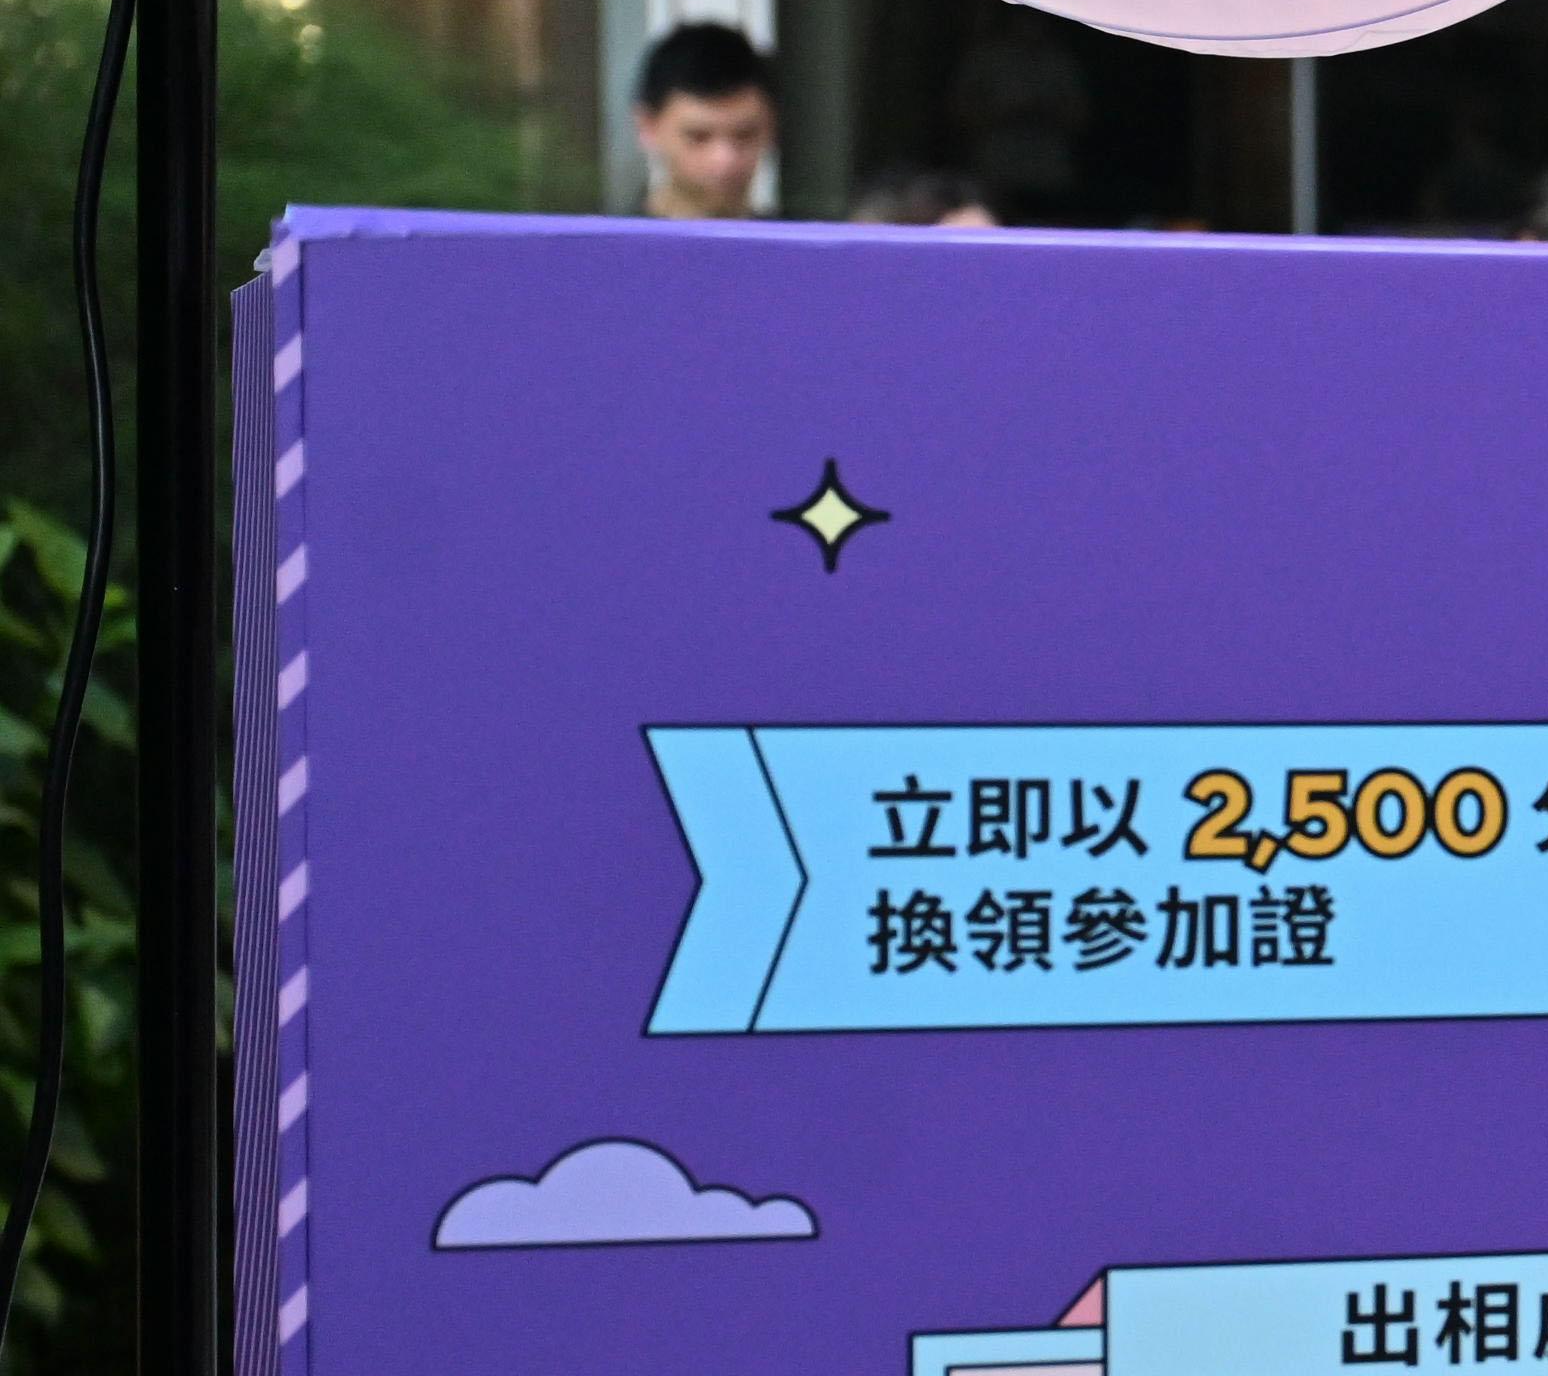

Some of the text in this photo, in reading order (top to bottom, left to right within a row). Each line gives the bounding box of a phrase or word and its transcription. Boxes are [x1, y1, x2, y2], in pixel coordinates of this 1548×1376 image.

[867, 775, 1149, 861] 立即以
[1182, 767, 1508, 875] 2,500
[867, 883, 1336, 974] 換領參加證
